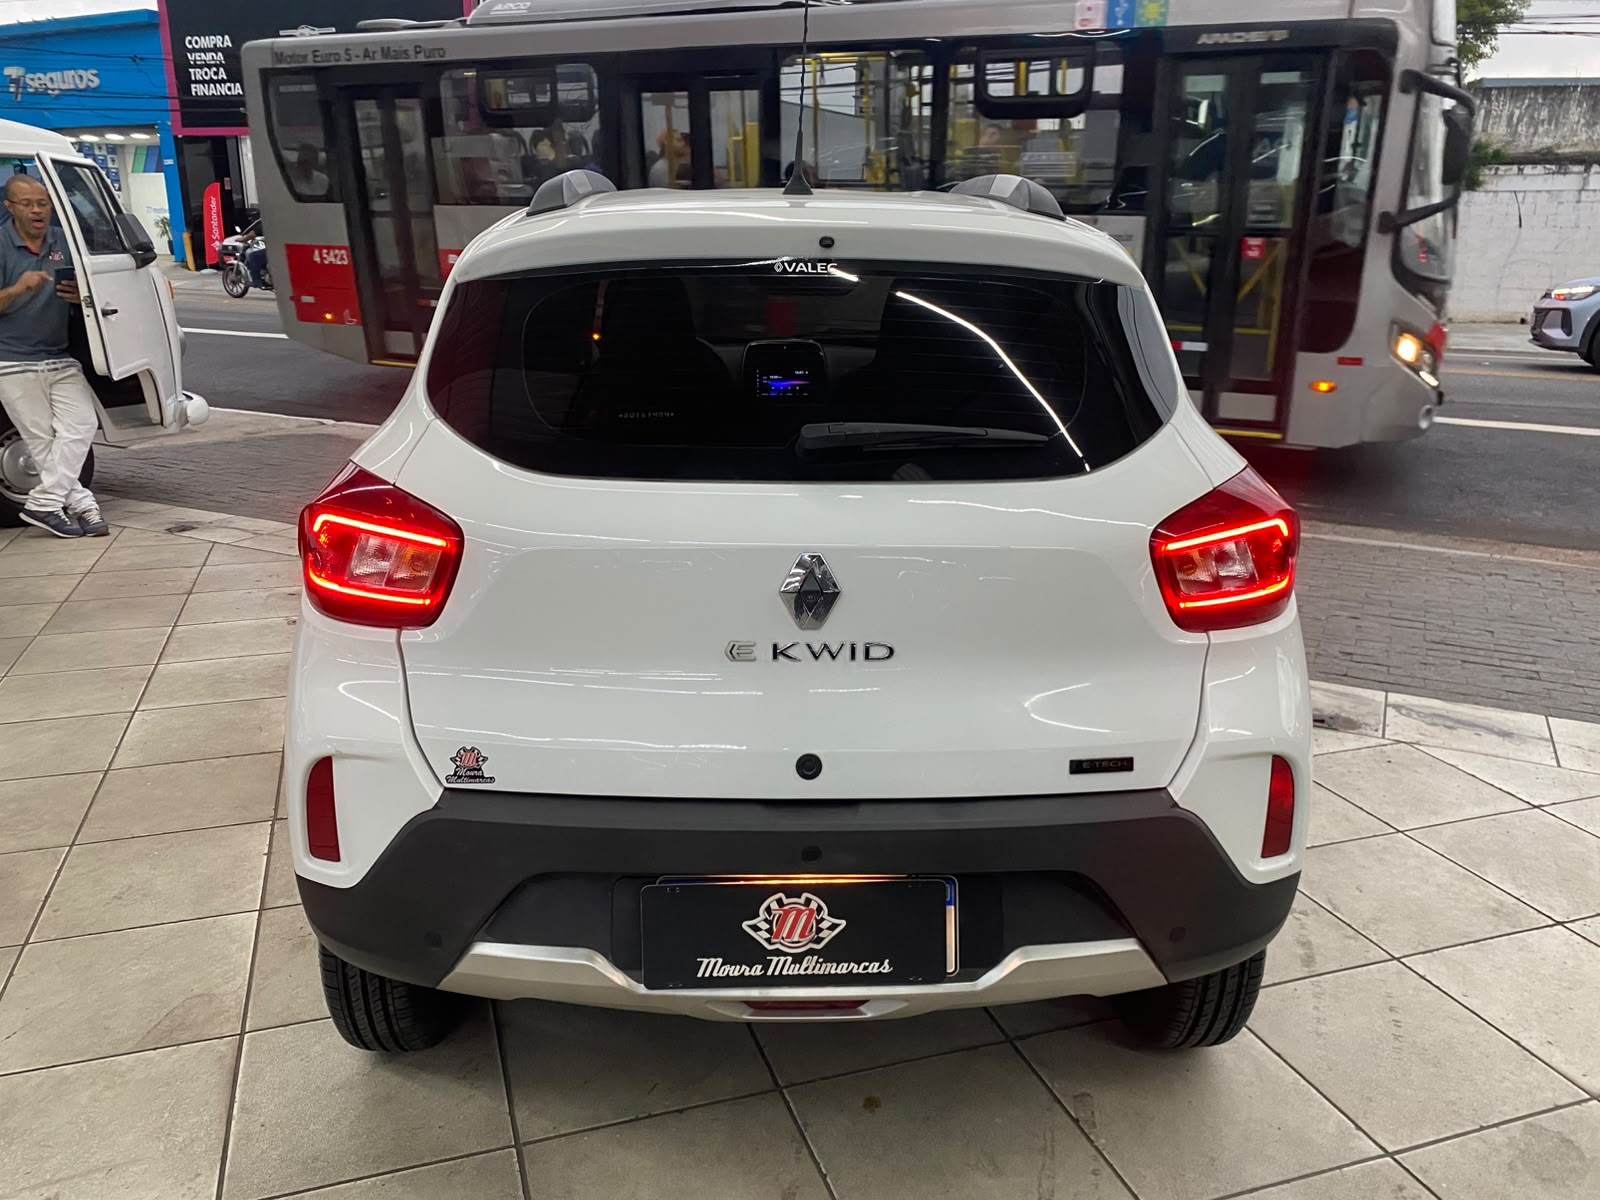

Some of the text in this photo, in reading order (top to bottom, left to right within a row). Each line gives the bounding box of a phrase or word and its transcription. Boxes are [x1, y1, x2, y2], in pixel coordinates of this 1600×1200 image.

[185, 35, 232, 49] COMPRA
[186, 52, 226, 64] VENDA
[274, 51, 308, 65] Motor
[311, 50, 341, 63] Euro
[363, 47, 377, 61] Ar
[381, 46, 409, 60] Mais
[414, 45, 446, 59] Puro
[188, 67, 228, 80] TROCA
[25, 69, 100, 97] seguros
[190, 82, 244, 96] FINANCIA
[211, 195, 220, 240] Santander
[322, 249, 349, 265] 5423
[771, 640, 896, 662] KWID
[456, 768, 483, 776] Moura
[696, 955, 894, 978] Moura Multimarcas
